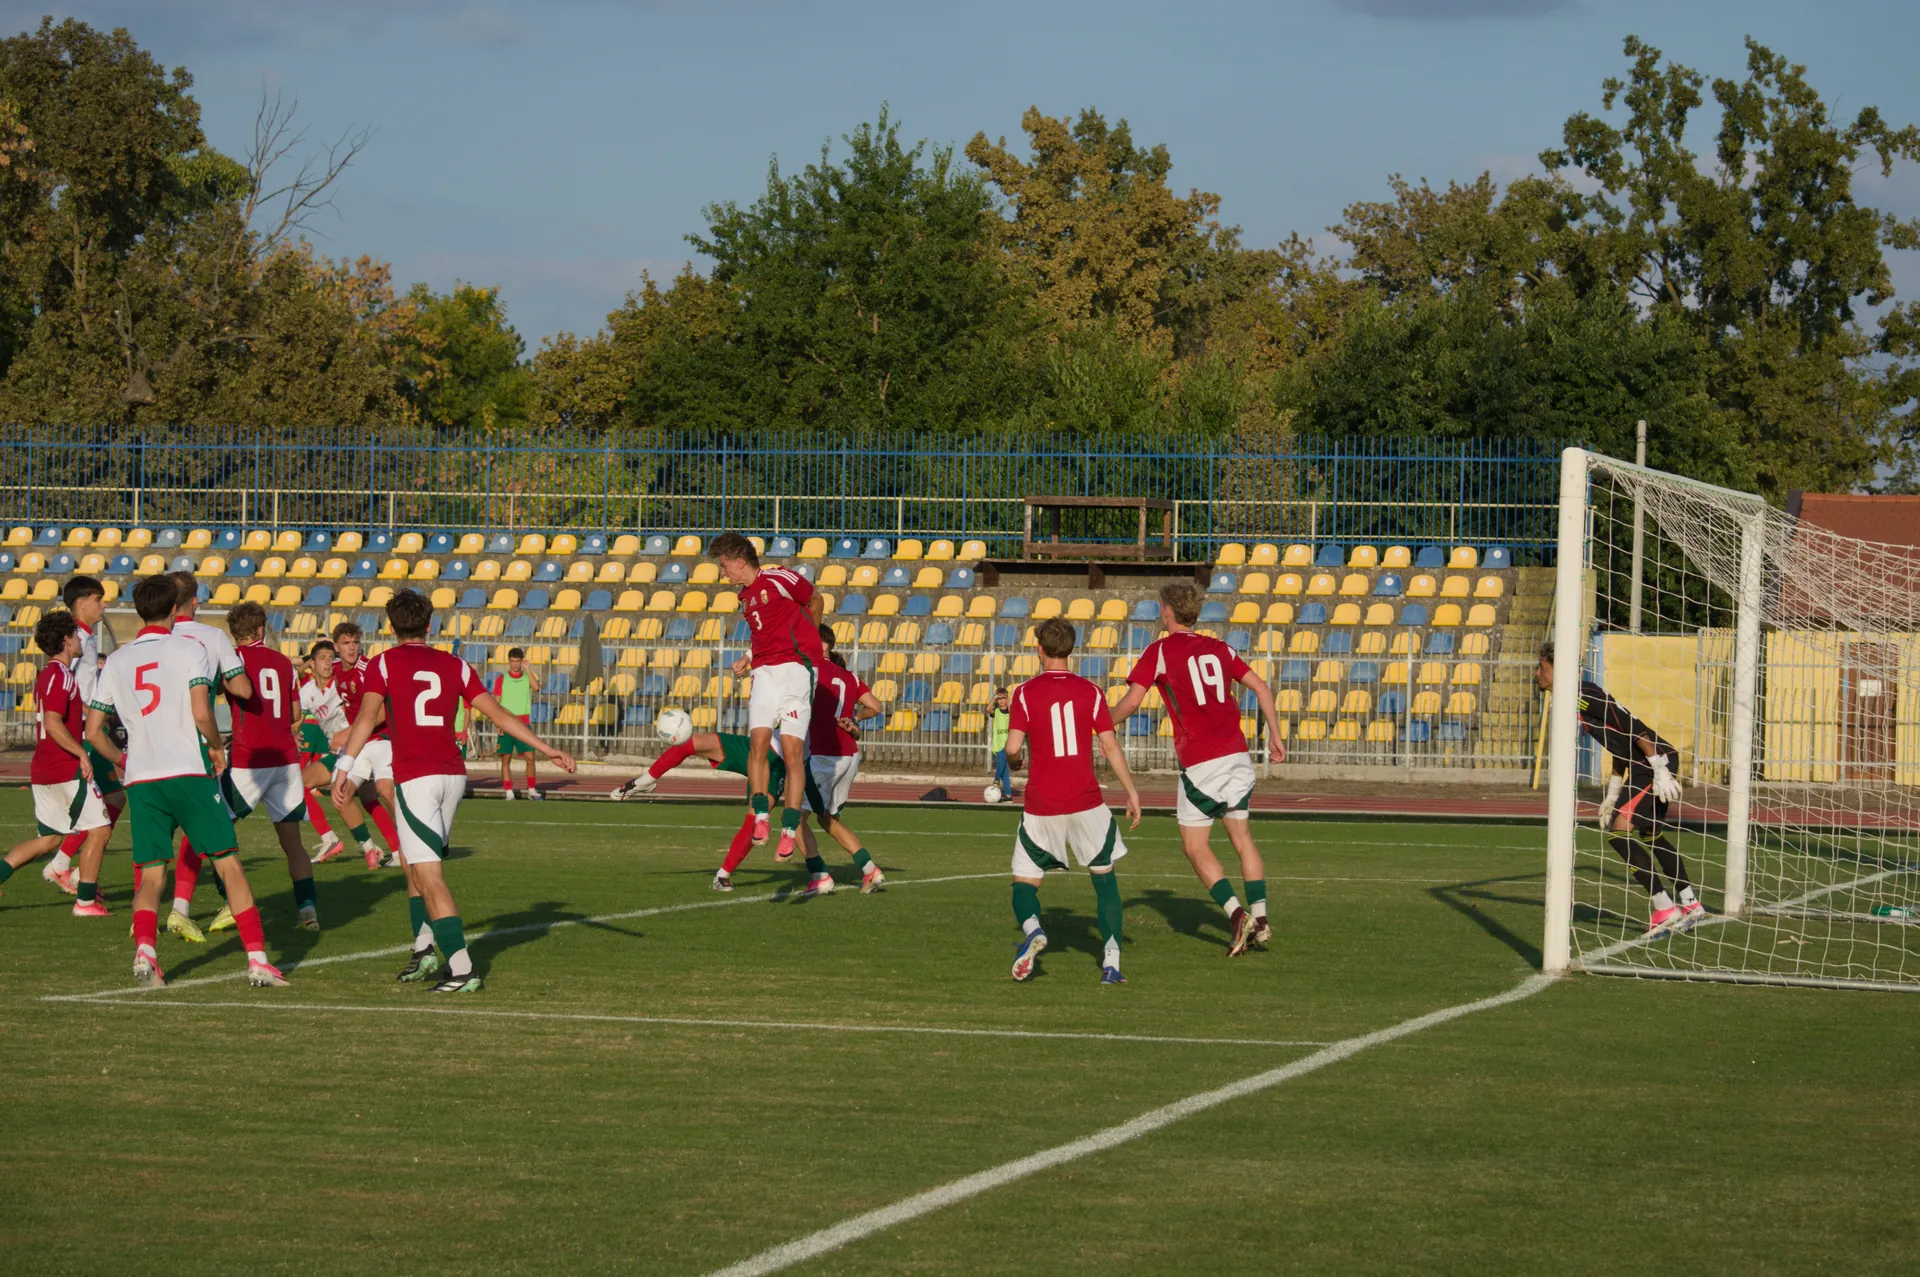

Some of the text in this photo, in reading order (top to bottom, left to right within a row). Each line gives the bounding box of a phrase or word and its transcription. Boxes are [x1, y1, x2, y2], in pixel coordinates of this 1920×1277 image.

[752, 611, 763, 630] 3
[134, 661, 161, 717] 5
[259, 667, 281, 719] 9
[412, 670, 444, 726] 2
[831, 677, 846, 719] 7
[1187, 653, 1225, 706] 19
[1050, 700, 1078, 757] 11
